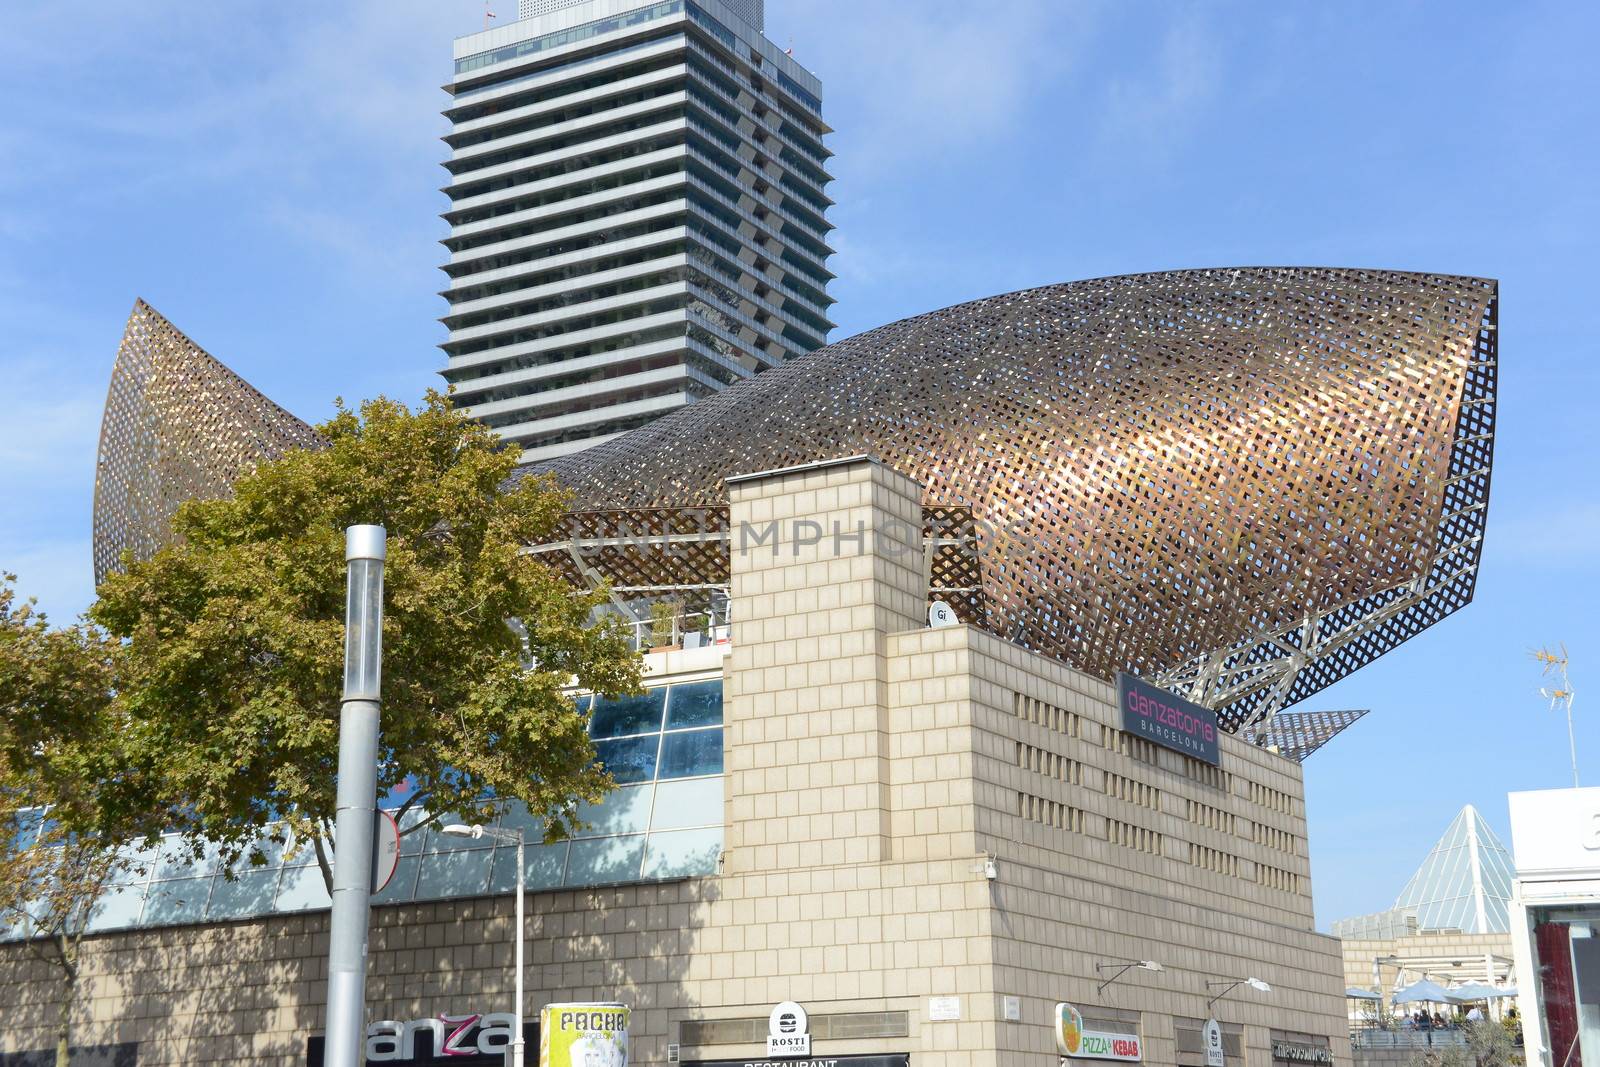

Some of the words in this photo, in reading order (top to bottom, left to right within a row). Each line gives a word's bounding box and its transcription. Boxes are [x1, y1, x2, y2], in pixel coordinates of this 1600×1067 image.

[1128, 687, 1214, 743] danzatoria
[1141, 720, 1206, 753] BARCELONA
[561, 1012, 624, 1031] PACHA
[772, 1037, 804, 1046] ROSTI
[1082, 1036, 1108, 1054] PIZZA
[1113, 1039, 1139, 1057] KEBAB
